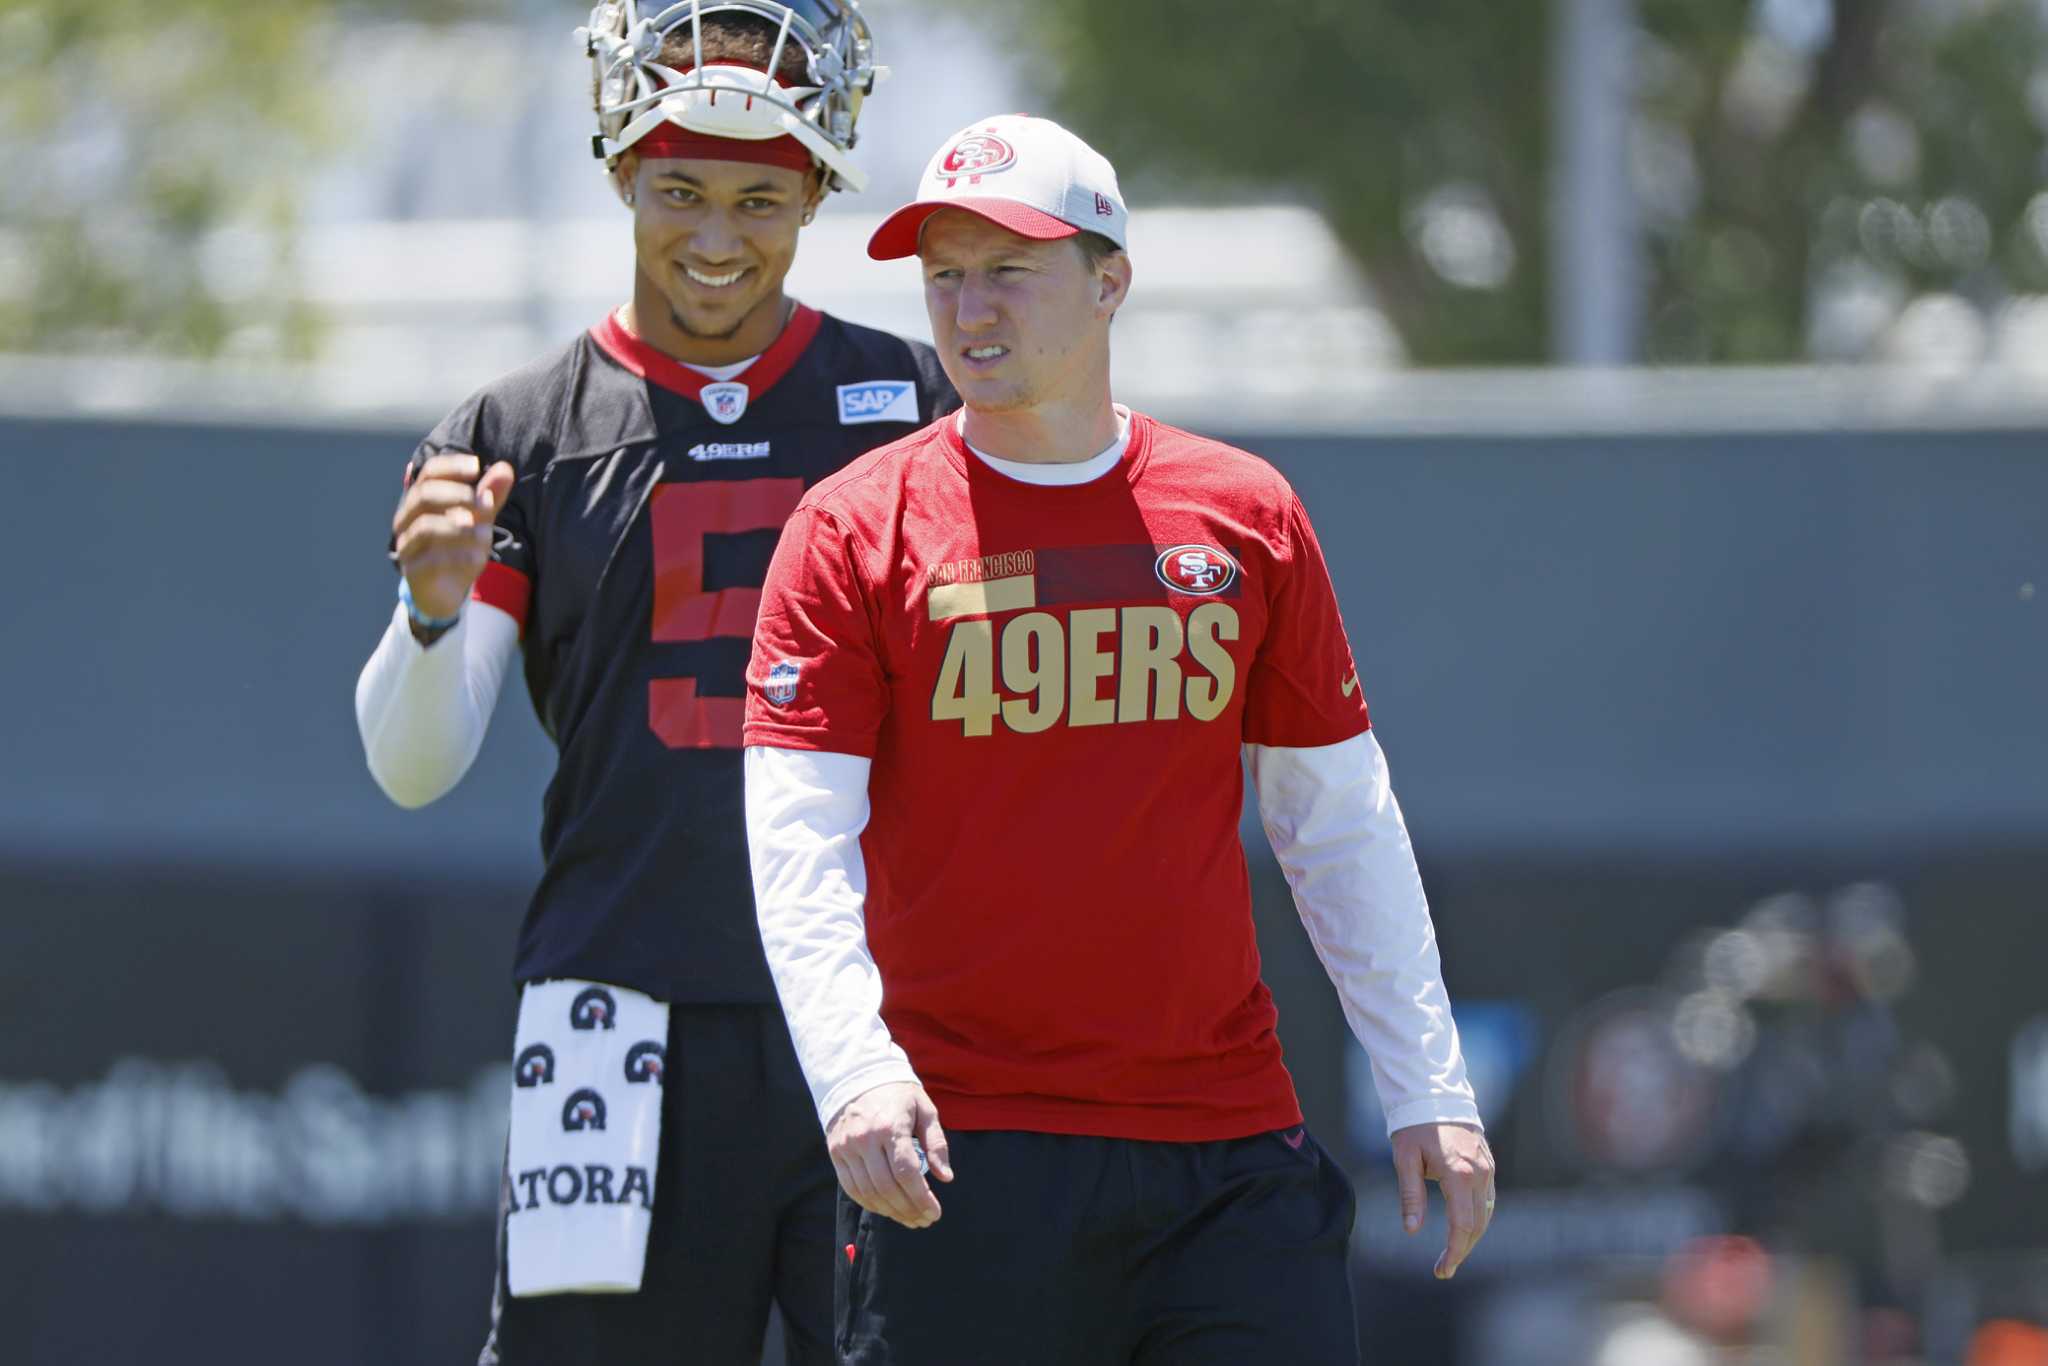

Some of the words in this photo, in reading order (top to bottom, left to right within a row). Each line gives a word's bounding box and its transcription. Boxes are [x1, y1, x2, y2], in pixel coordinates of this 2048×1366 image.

[844, 390, 895, 412] SAP
[687, 441, 771, 462] 49ERS
[927, 562, 955, 586] SAN
[958, 549, 1034, 583] FRANCISCO
[1179, 553, 1221, 587] SF
[931, 603, 1239, 737] 49ERS
